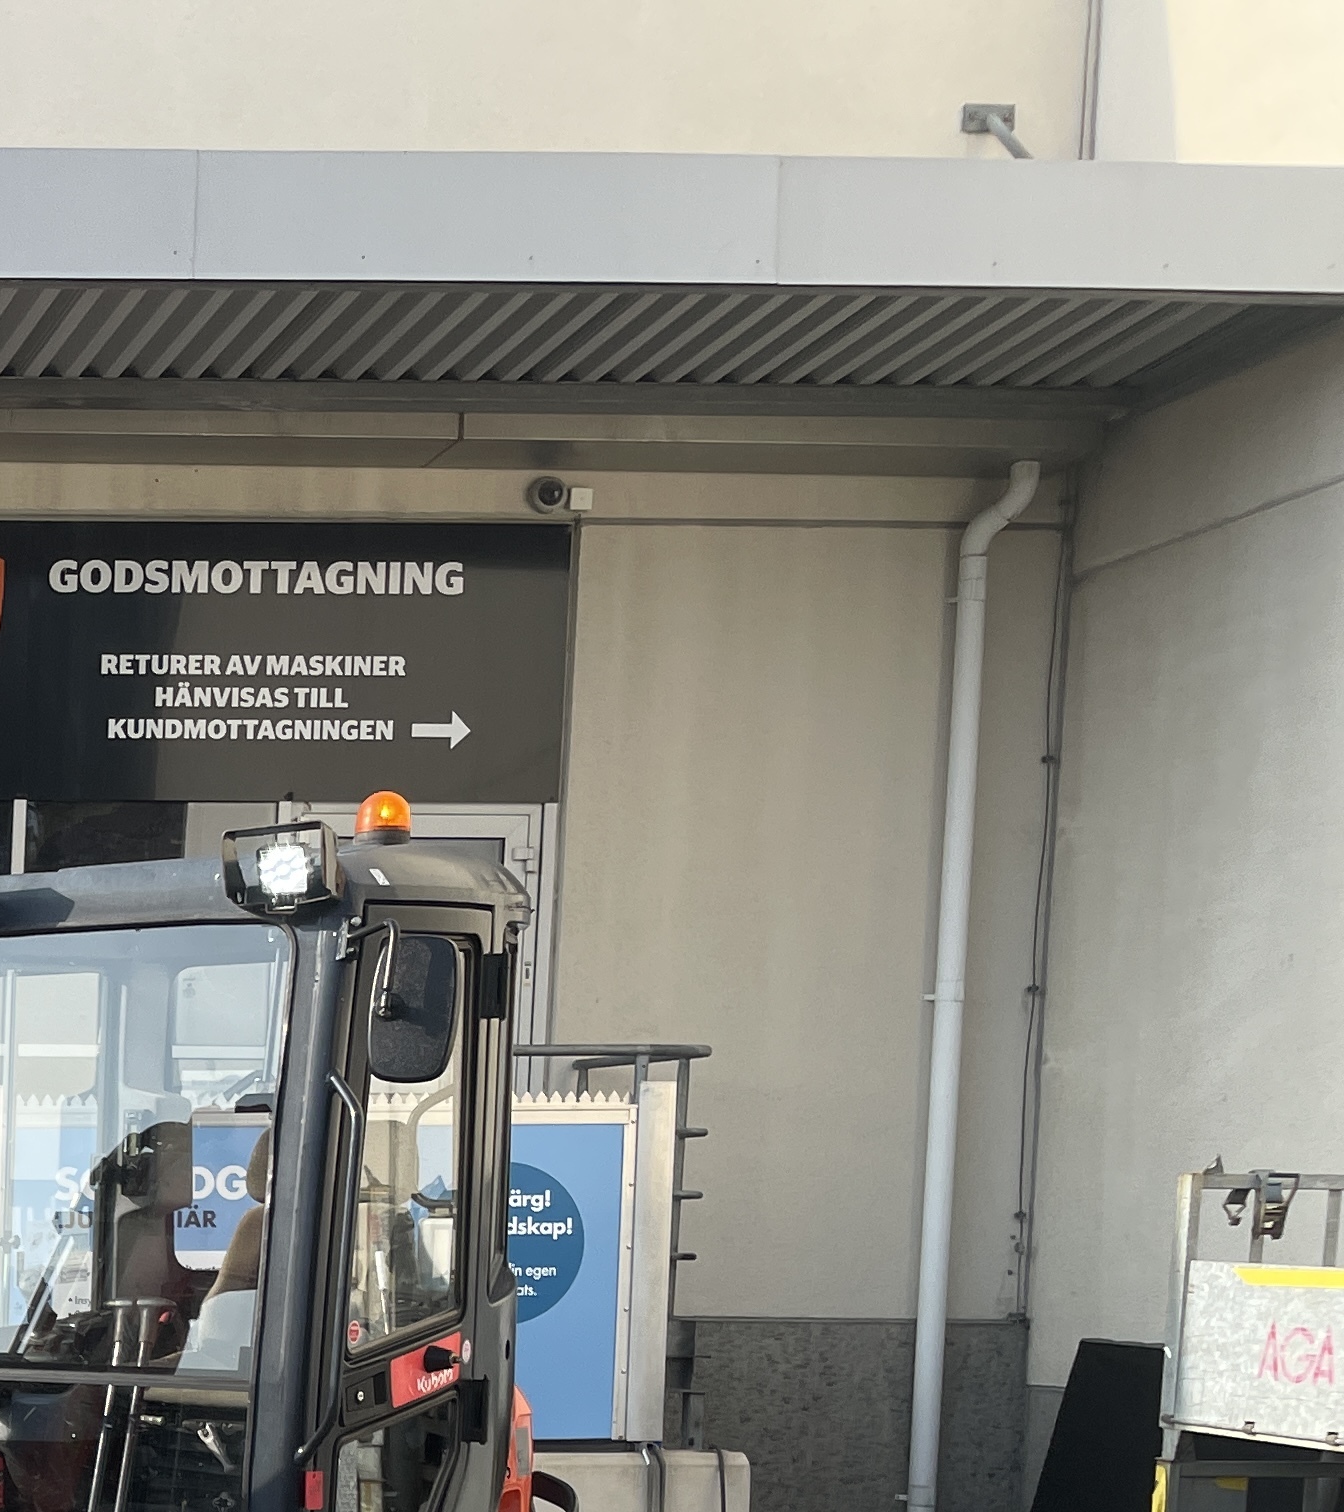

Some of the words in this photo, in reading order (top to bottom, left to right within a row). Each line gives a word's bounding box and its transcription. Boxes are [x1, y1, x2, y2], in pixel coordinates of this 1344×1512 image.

[49, 559, 465, 595] GODSMOTTAGNING
[100, 654, 221, 676] RETURER
[225, 654, 262, 676] AV
[266, 655, 406, 677] MASKINER
[154, 681, 290, 708] HÄNVISAS
[293, 687, 349, 708] TILL
[107, 718, 394, 741] KUNDMOTTAGNINGEN
[508, 1189, 551, 1213] ärg!
[507, 1216, 573, 1241] dskap!
[525, 1266, 557, 1280] egen
[1256, 1318, 1335, 1387] AGA
